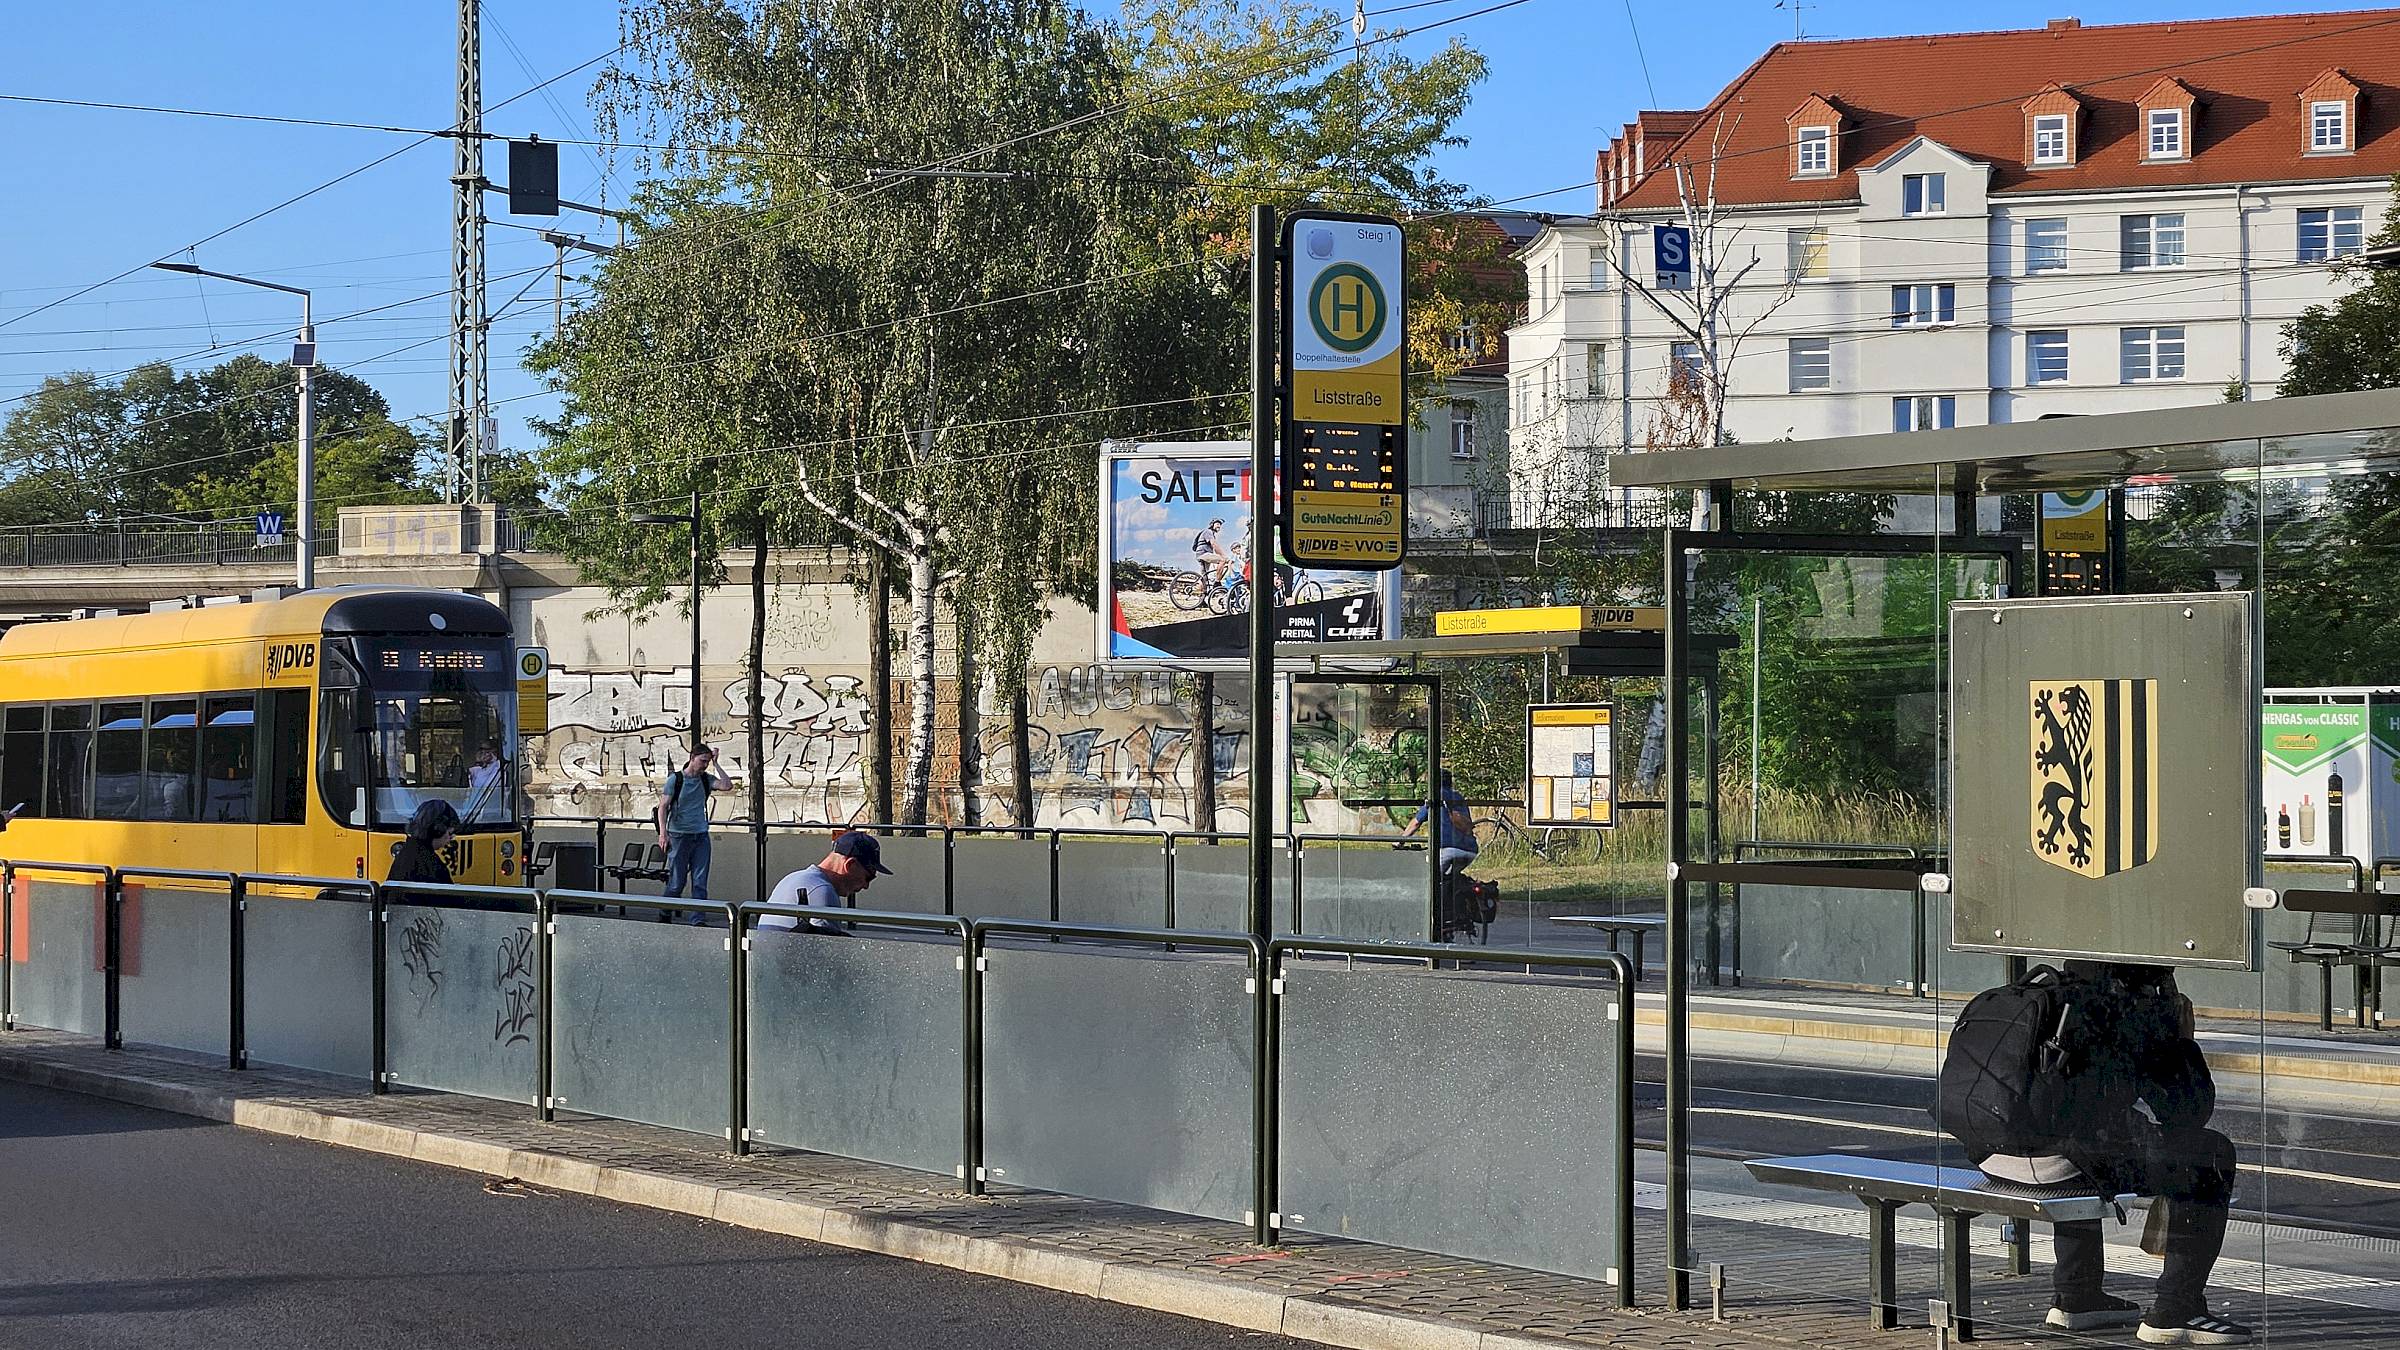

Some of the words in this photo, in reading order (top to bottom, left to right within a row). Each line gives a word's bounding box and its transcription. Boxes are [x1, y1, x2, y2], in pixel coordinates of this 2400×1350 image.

[1357, 229, 1384, 242] Steig
[1387, 231, 1392, 240] 1
[1662, 232, 1683, 265] S
[1332, 282, 1363, 332] H
[1295, 352, 1361, 364] Doppelhaltestelle
[1314, 387, 1382, 407] Liststraße
[1141, 470, 1236, 504] SALE
[258, 516, 281, 534] W
[1301, 512, 1383, 526] GuteNachtLinie
[264, 535, 276, 545] 40
[2055, 530, 2095, 541] Liststraße
[1312, 539, 1338, 551] DVB
[1355, 540, 1383, 552] VVO
[1288, 617, 1316, 627] PIRNA
[1442, 614, 1487, 631] Liststraße
[1606, 609, 1634, 623] DVB
[1280, 629, 1315, 638] FREITAL
[1327, 627, 1378, 637] CUBE
[282, 643, 315, 668] DVB
[528, 658, 537, 671] H
[2320, 713, 2359, 726] CLASSIC
